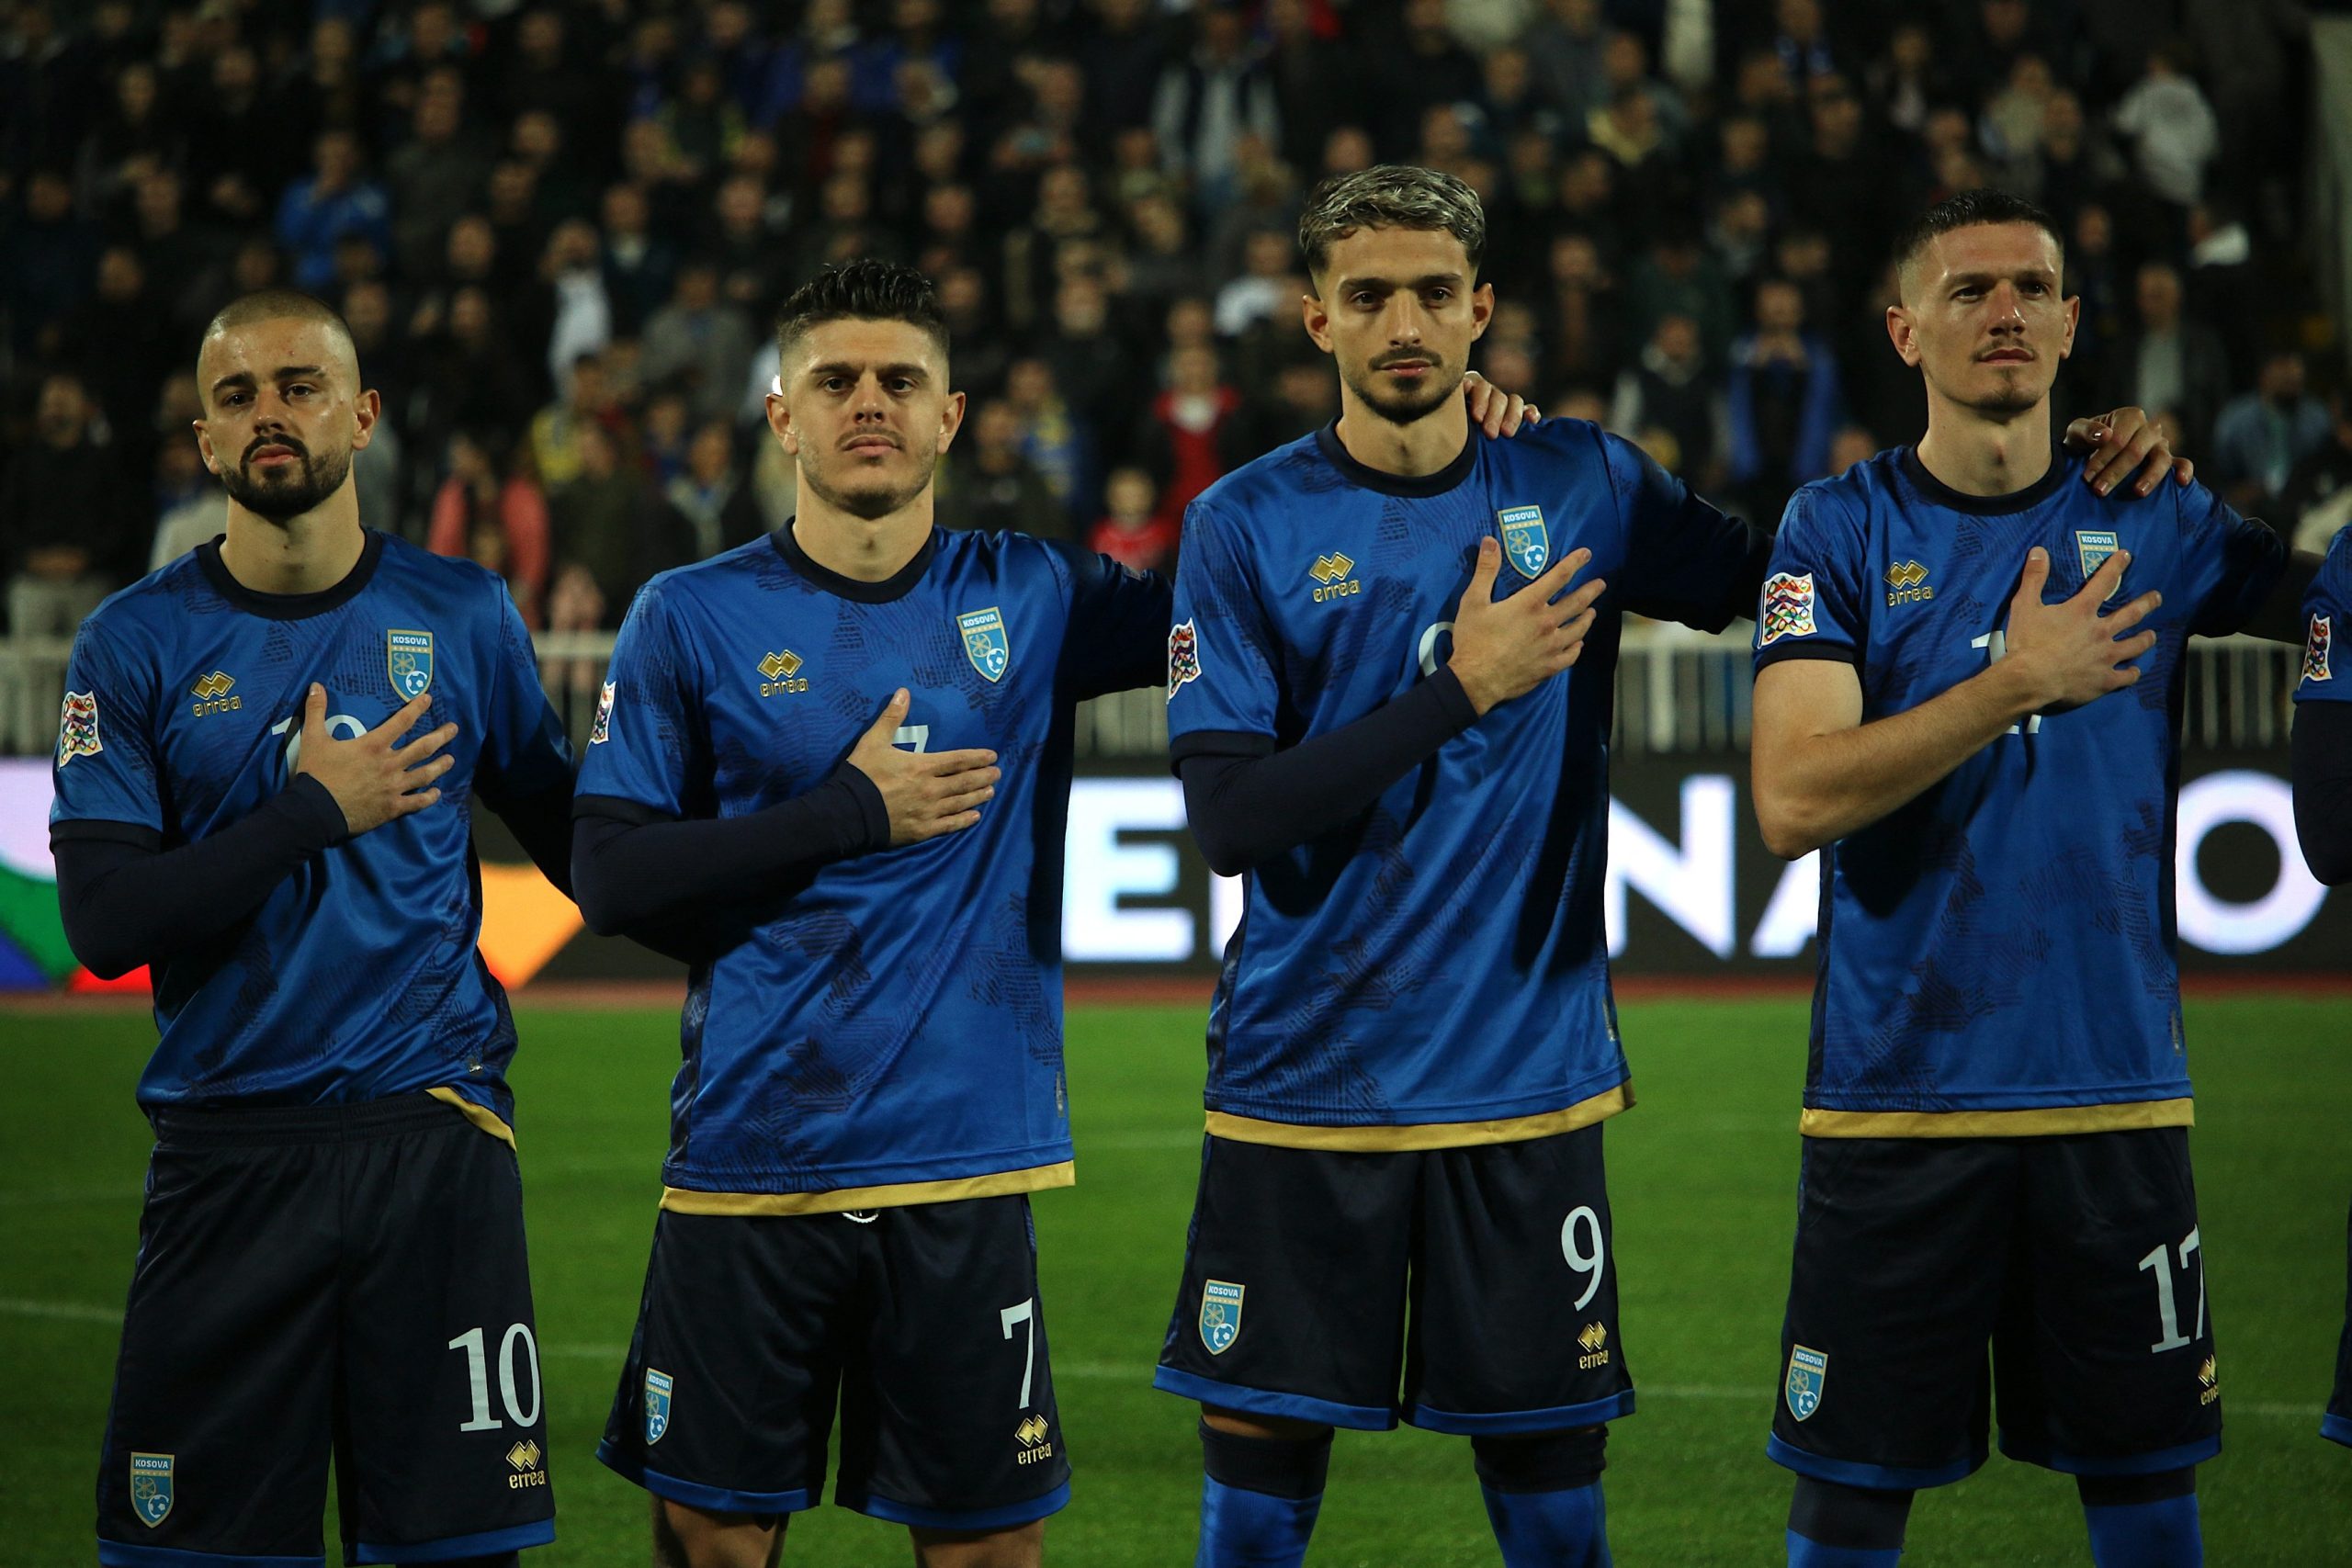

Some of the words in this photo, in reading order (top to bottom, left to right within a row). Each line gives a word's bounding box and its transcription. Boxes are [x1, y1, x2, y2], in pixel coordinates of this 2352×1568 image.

[1502, 510, 1539, 525] KOSOVA
[2081, 535, 2114, 547] KOSOVA
[1312, 579, 1362, 603] errea
[1886, 585, 1935, 607] errea
[962, 612, 999, 628] KOSOVA
[391, 635, 429, 647] KOSOVA
[759, 677, 810, 698] errea
[192, 694, 243, 717] errea
[1560, 1204, 1606, 1313] 9
[1207, 1284, 1239, 1298] KOSOVA
[2138, 1222, 2204, 1354] 17
[1000, 1296, 1034, 1411] 7
[1577, 1348, 1610, 1371] errea
[1794, 1350, 1825, 1368] KOSOVA
[448, 1322, 542, 1432] 10
[647, 1374, 671, 1391] KOSOVA
[134, 1458, 169, 1470] KOSOVA
[1016, 1441, 1054, 1466] errea
[508, 1469, 547, 1490] errea
